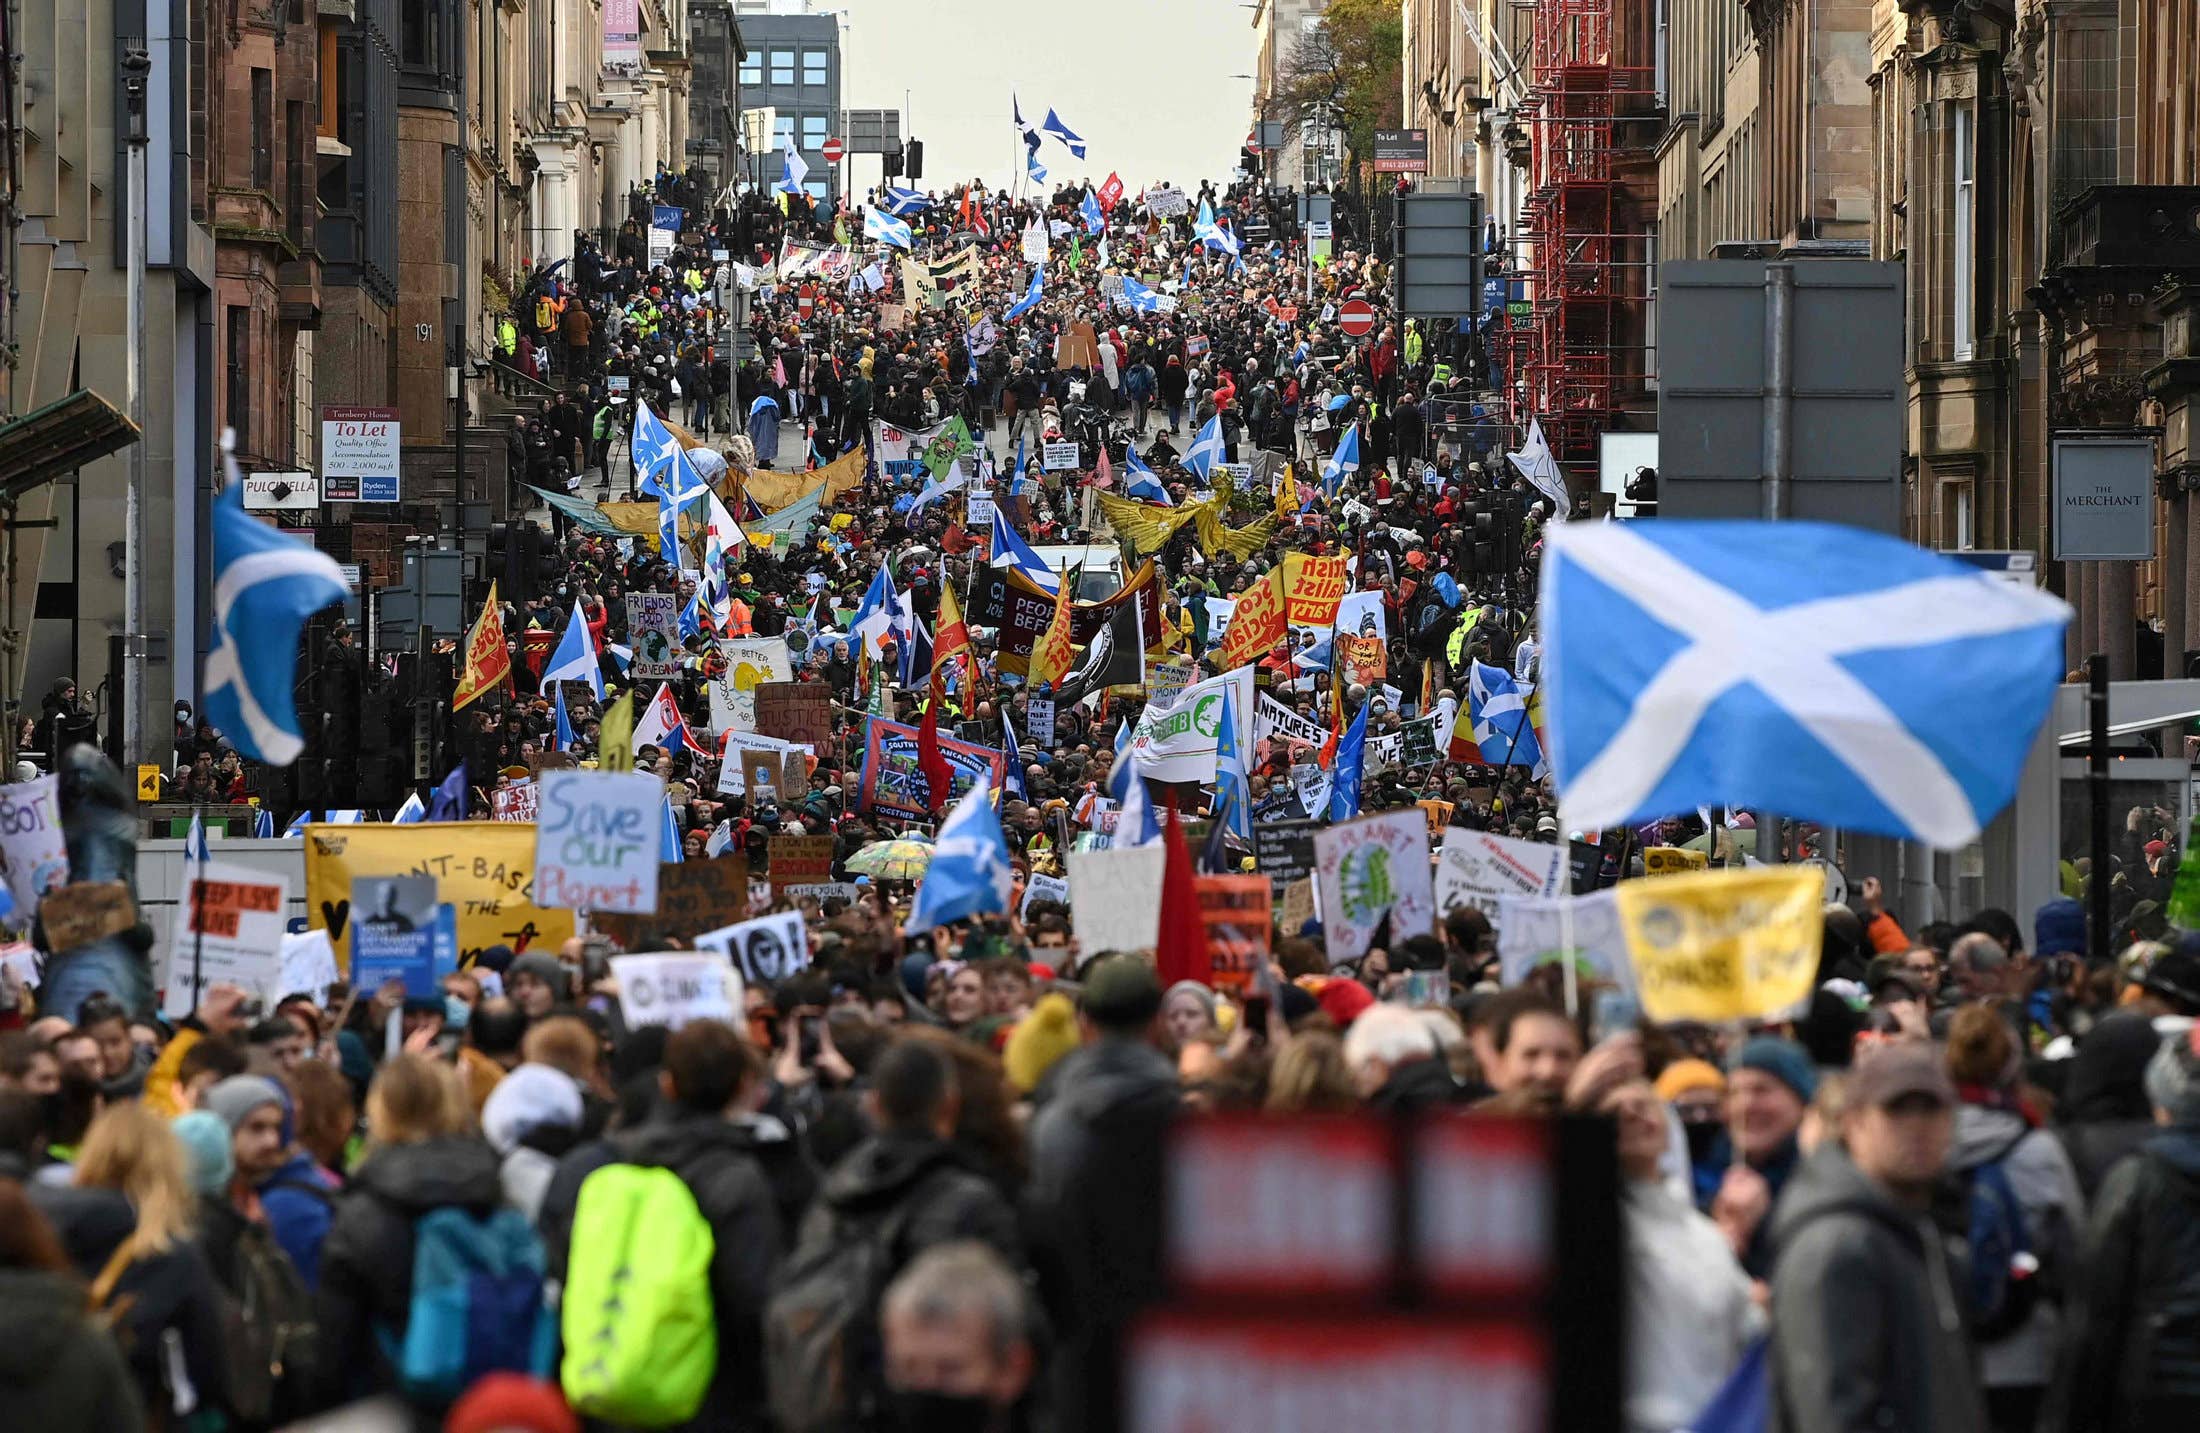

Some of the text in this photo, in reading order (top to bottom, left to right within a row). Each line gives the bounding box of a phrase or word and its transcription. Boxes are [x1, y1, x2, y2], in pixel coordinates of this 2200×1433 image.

[1376, 133, 1398, 141] To Let
[415, 323, 432, 342] 191
[332, 410, 391, 420] Turnberry House
[335, 422, 387, 437] To Let
[882, 428, 902, 442] END
[334, 439, 388, 448] Quality Office
[331, 450, 390, 459] Accommodation
[328, 461, 345, 470] 500
[886, 462, 915, 476] DUMP
[2065, 495, 2142, 506] MERCHANT
[627, 595, 673, 610] FRIENDS
[986, 602, 1004, 618] JOB
[1086, 609, 1096, 620] &
[1351, 639, 1371, 651] FOR
[741, 648, 769, 664] BETTER
[637, 663, 675, 675] GO VEGAN
[758, 684, 831, 708] CLIMATE
[1032, 700, 1047, 709] NO
[757, 708, 831, 727] JUSTICE
[1260, 698, 1322, 744] NATURE'S
[732, 737, 750, 746] Peter
[888, 741, 914, 751] SOUTH
[940, 747, 983, 773] ANCASHIRE
[720, 779, 736, 788] STOP
[497, 783, 540, 807] DESTR
[518, 799, 537, 810] THE
[543, 777, 645, 842] Save
[875, 805, 915, 820] TOGETHER
[538, 864, 644, 907] Planet
[818, 885, 844, 896] YOUR
[464, 900, 502, 917] THE
